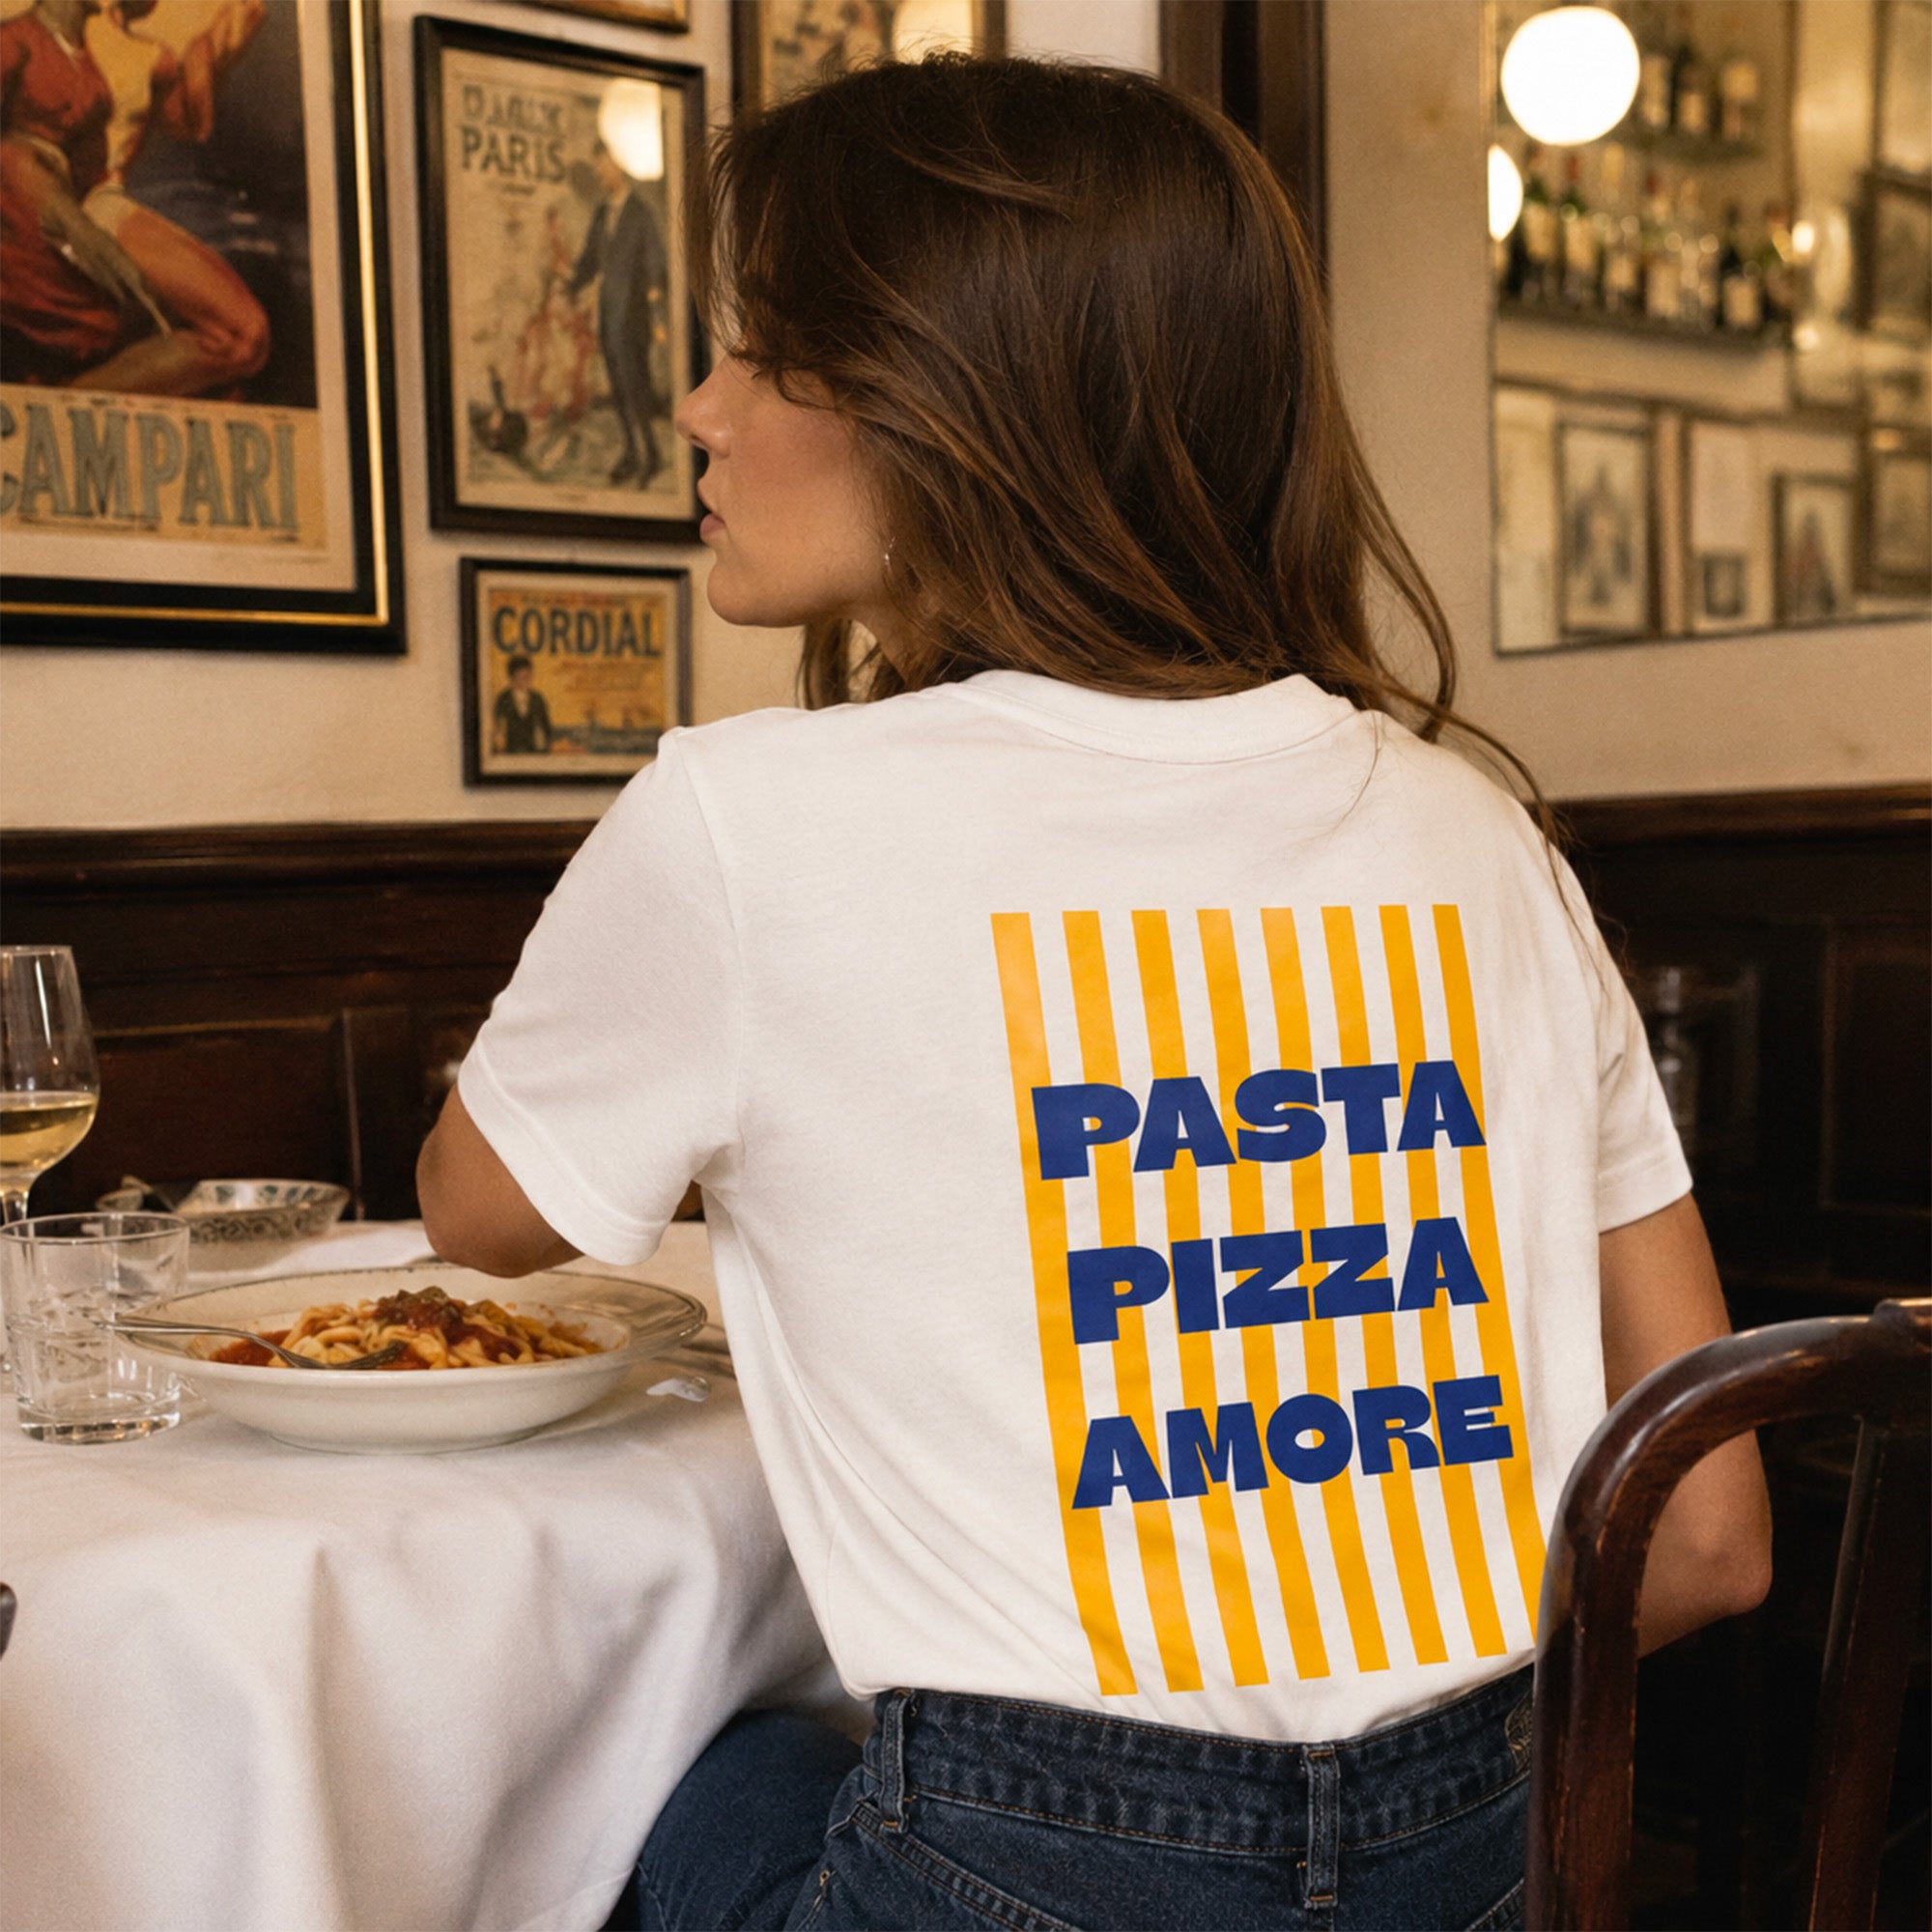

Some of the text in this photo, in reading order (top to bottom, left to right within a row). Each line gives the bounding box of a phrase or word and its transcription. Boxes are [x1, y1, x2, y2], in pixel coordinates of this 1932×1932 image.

[460, 124, 566, 184] PARIS
[493, 605, 663, 659] CORDIAL
[1032, 1060, 1486, 1180] PASTA
[1067, 1216, 1489, 1345] PIZZA
[1072, 1375, 1514, 1509] AMORE
